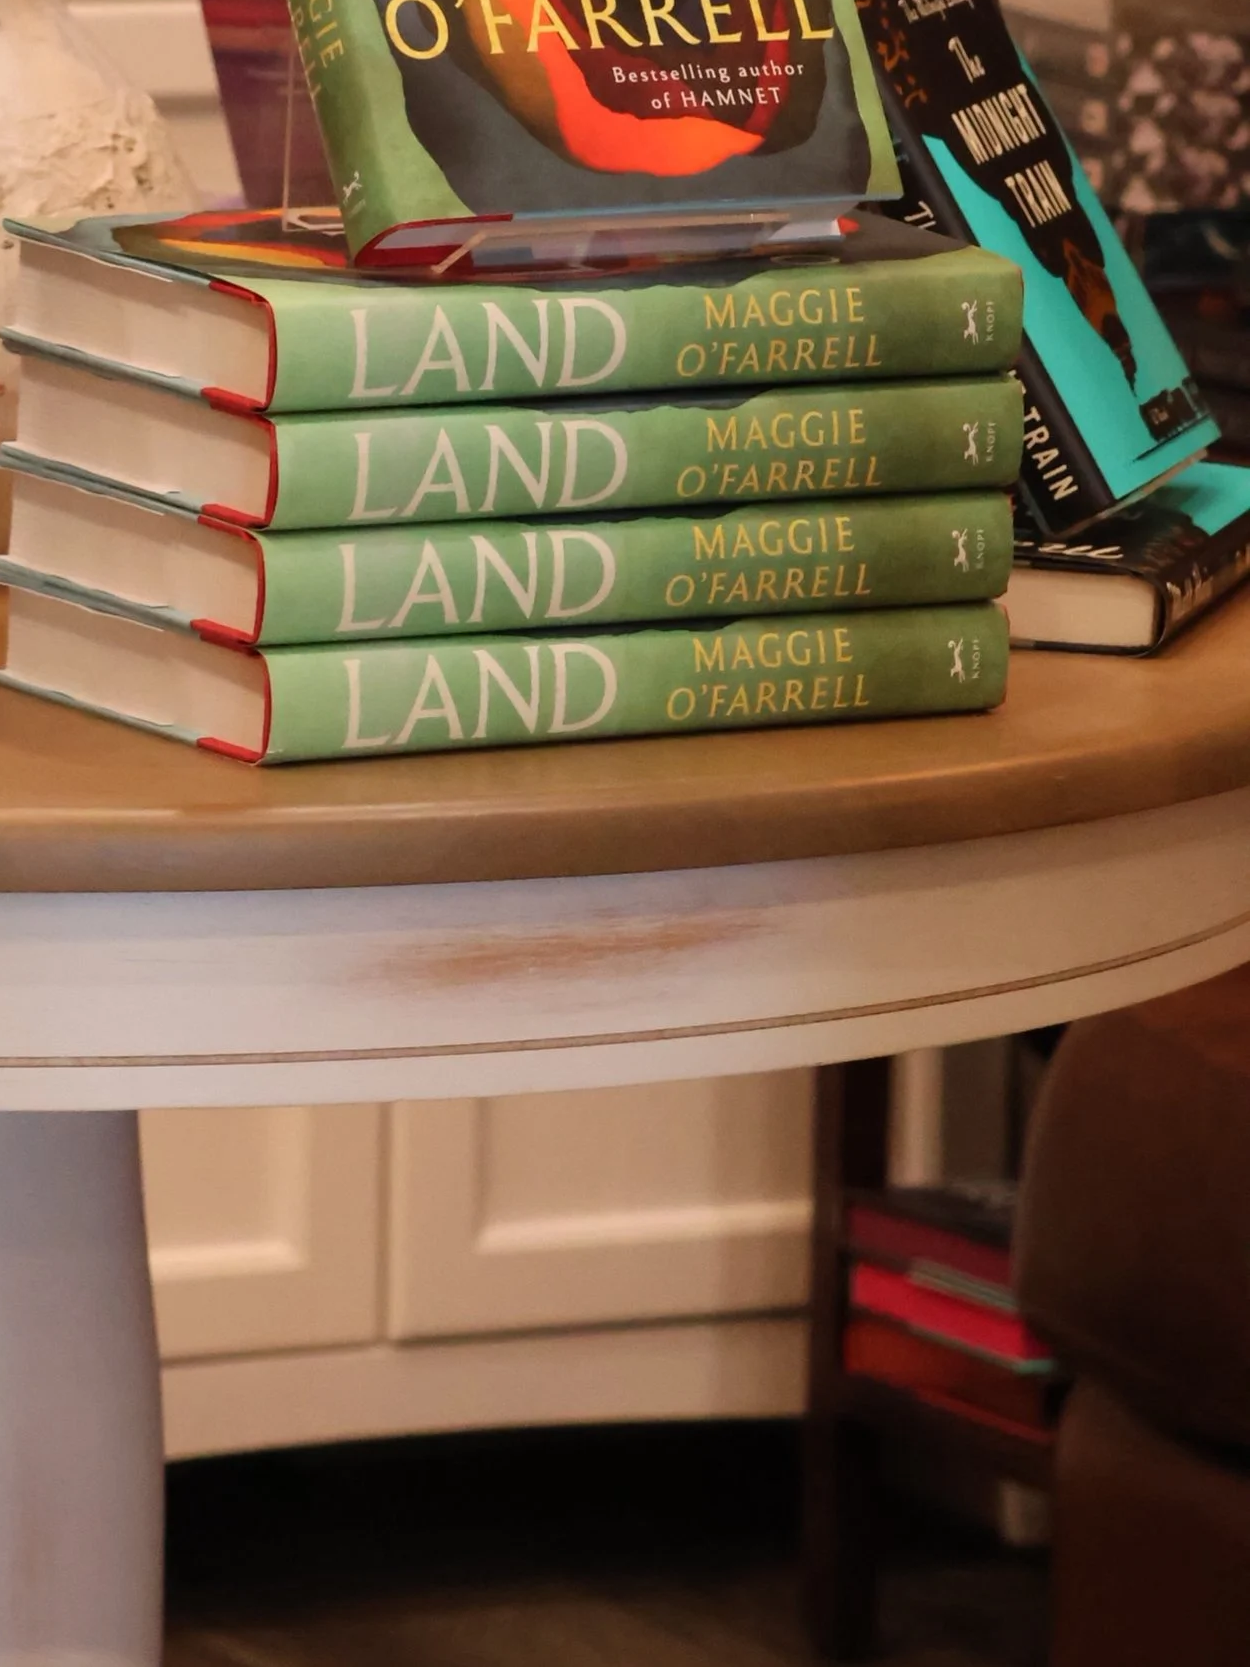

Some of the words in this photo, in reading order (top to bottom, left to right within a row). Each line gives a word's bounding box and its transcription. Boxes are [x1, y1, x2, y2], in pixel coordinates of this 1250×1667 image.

[611, 62, 731, 84] Bestselling
[737, 59, 805, 78] author
[948, 35, 986, 84] The
[651, 89, 671, 110] of
[680, 86, 782, 108] HAMNET
[951, 83, 1047, 166] MIDNIGHT
[1003, 159, 1072, 228] TRAIN
[351, 297, 628, 400] LAND
[703, 286, 866, 329] MAGGIE
[986, 299, 996, 343] KNOPF
[675, 333, 883, 379] O'FARRELL
[351, 416, 629, 522] LAND
[705, 407, 867, 452] MAGGIE
[986, 421, 997, 463] KNOPF
[1023, 405, 1079, 502] TRAIN
[675, 455, 883, 501] O'FARRELL
[335, 529, 617, 634] LAND
[693, 516, 856, 562] MAGGIE
[664, 563, 873, 608] O'FARRELL
[970, 637, 980, 681] KNOPF
[340, 642, 618, 753] LAND
[692, 629, 853, 674] MAGGIE
[666, 675, 871, 721] O'FARRELL
